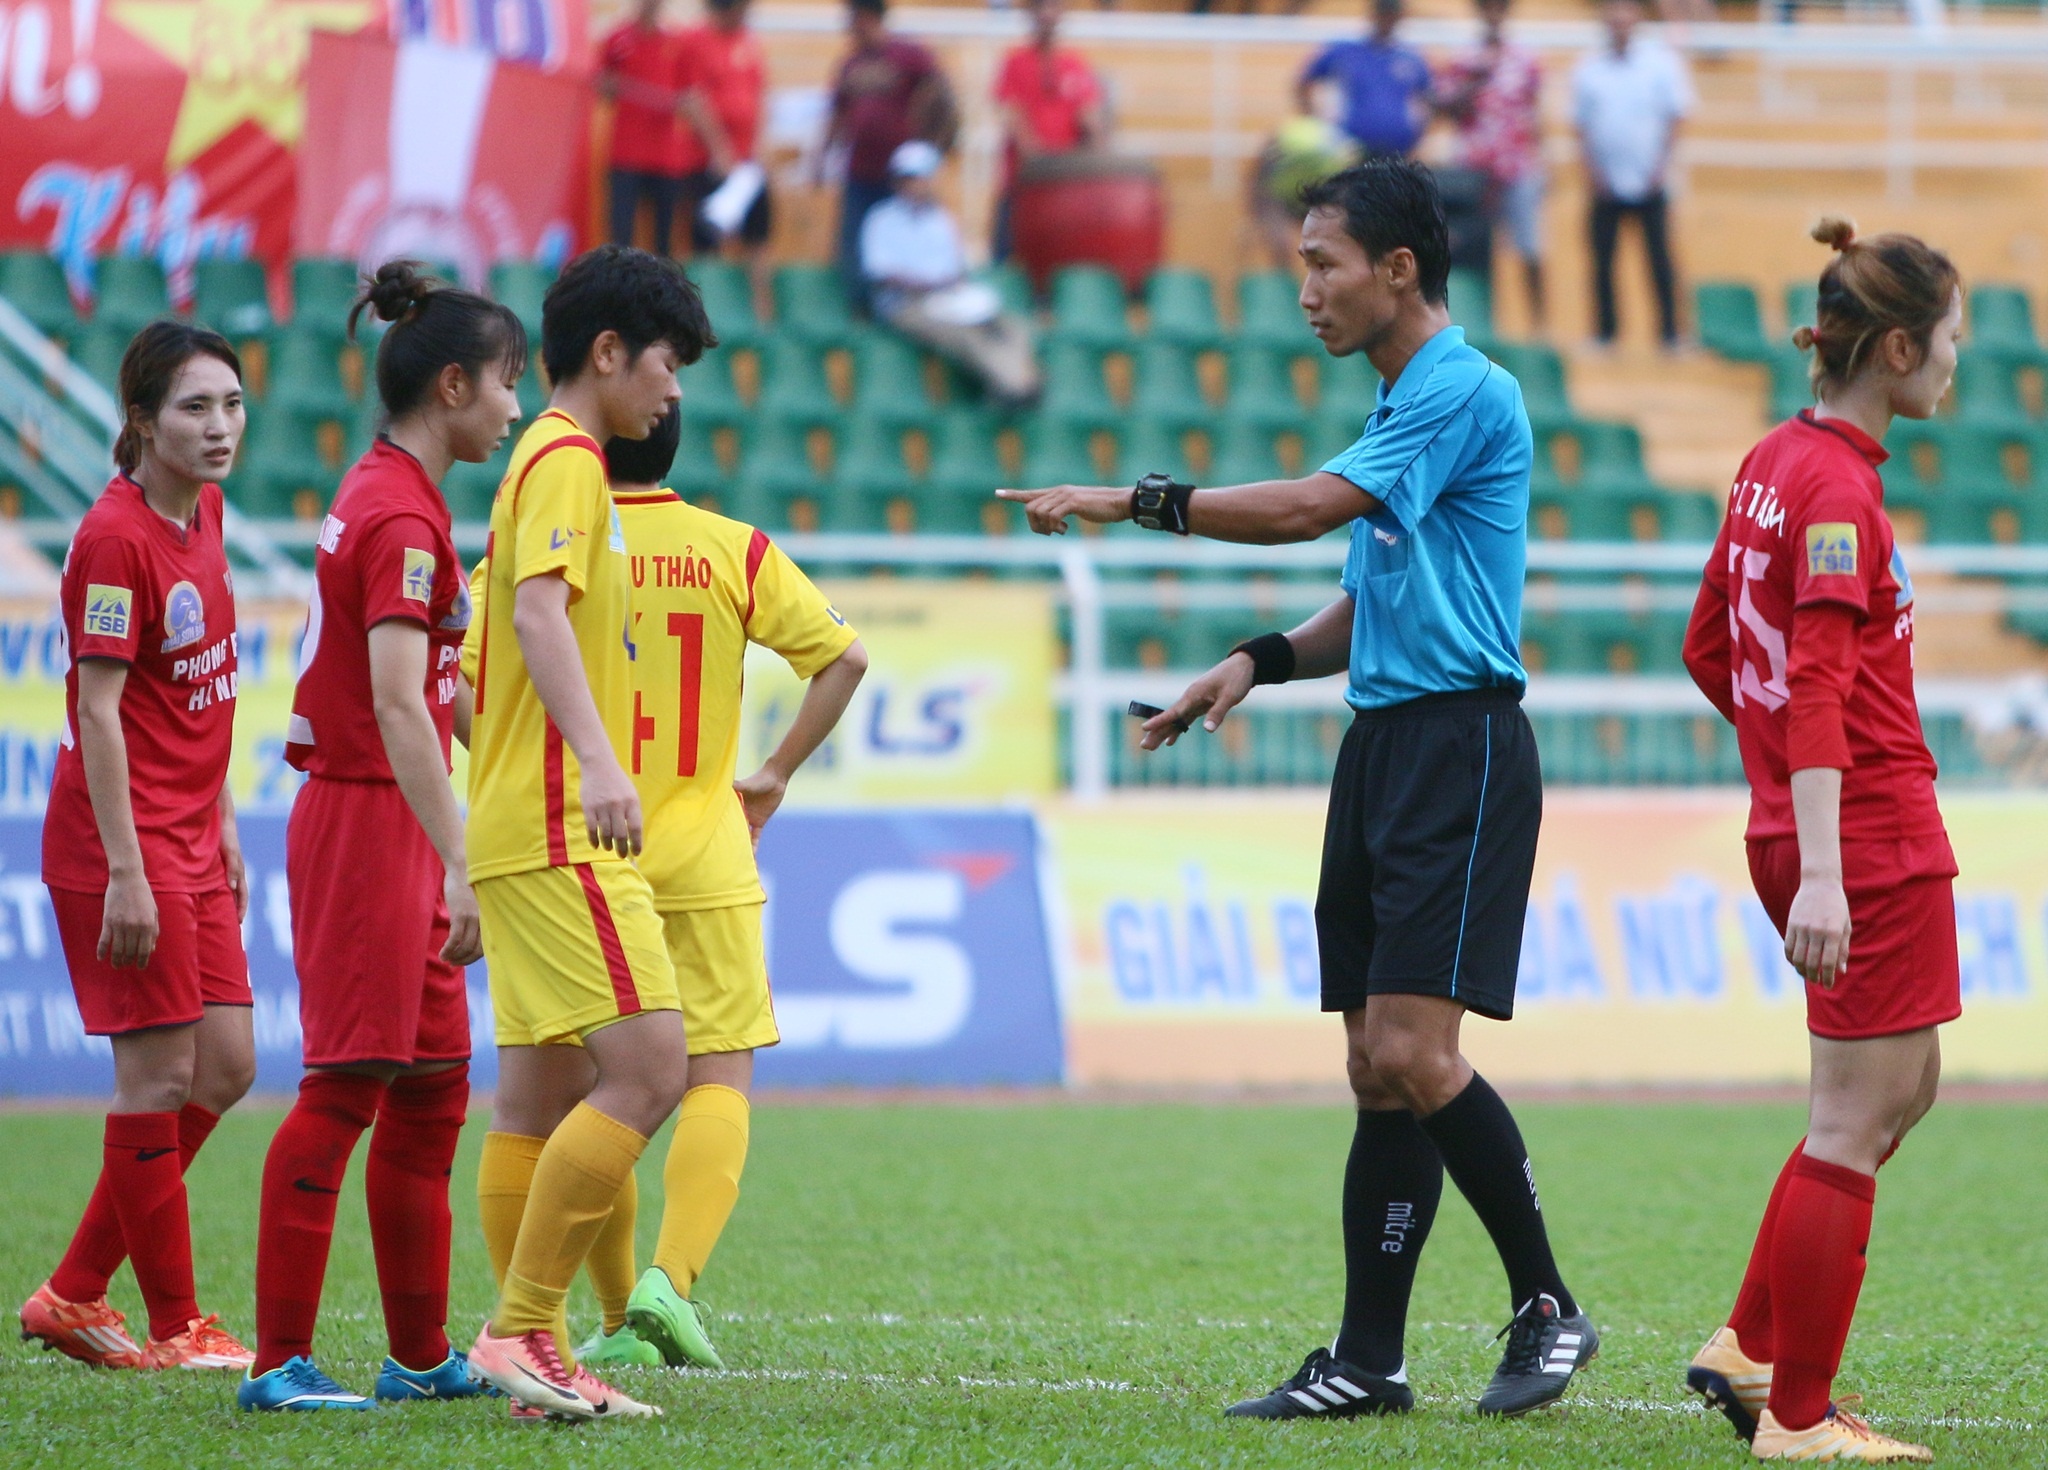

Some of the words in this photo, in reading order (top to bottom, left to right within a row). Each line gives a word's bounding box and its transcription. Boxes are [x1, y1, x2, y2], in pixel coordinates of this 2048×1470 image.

[652, 545, 712, 589] THẢO
[1810, 553, 1853, 571] TSB
[87, 614, 127, 635] TSB
[171, 638, 228, 681] PHONG
[867, 686, 966, 755] LS
[1380, 1202, 1417, 1254] mitre
